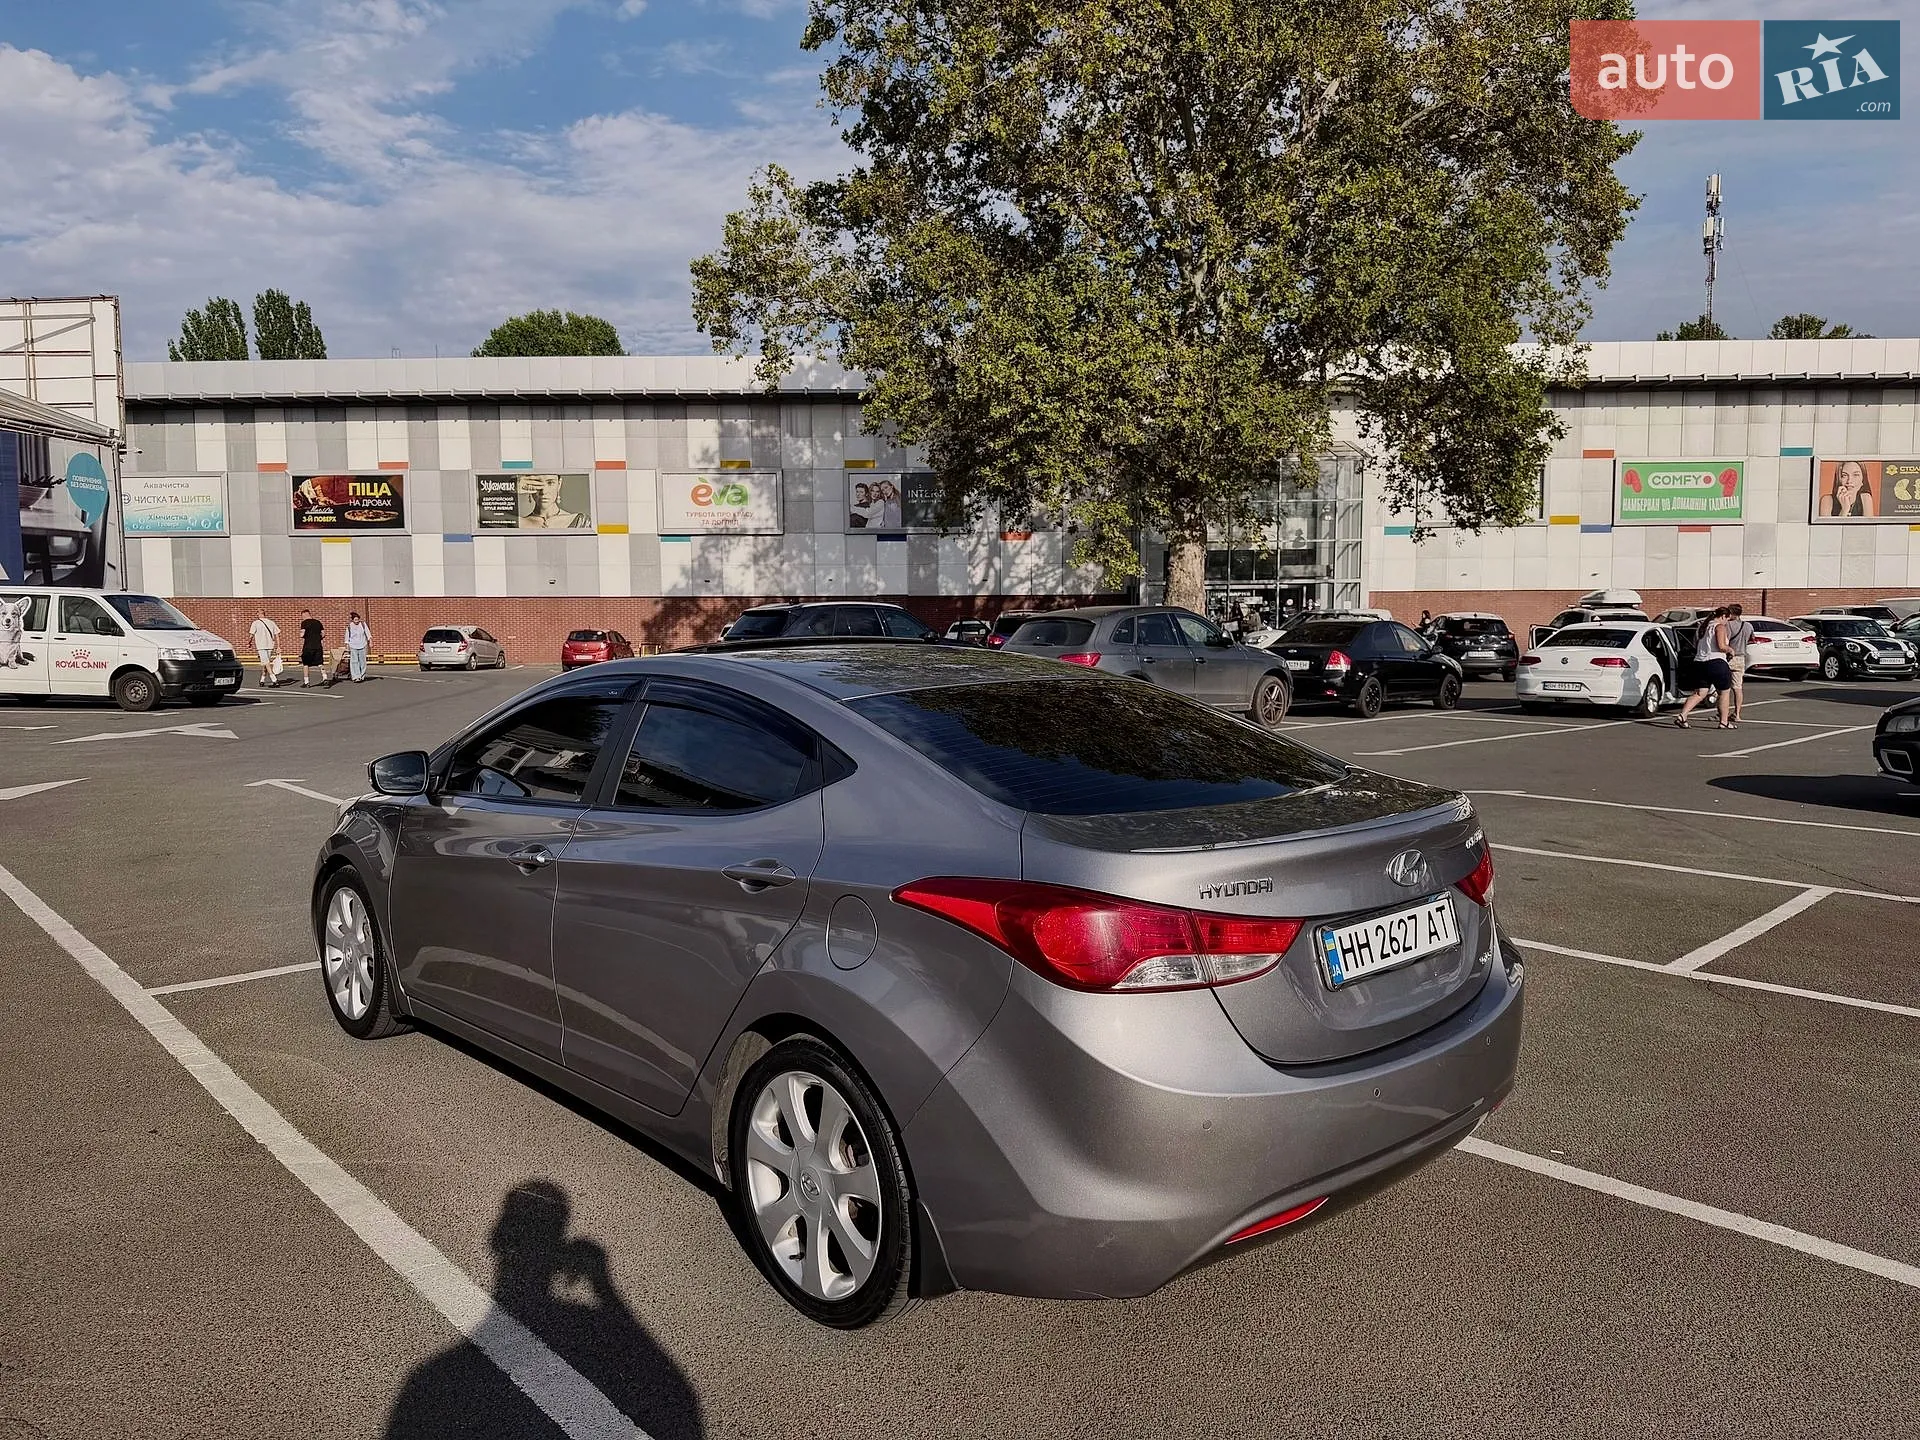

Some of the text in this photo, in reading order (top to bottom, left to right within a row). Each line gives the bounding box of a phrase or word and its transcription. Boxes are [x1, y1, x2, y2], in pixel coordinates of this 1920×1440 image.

[1652, 475, 1702, 486] COMFY
[348, 482, 392, 498] ПІЦА
[691, 482, 749, 507] eva
[133, 495, 211, 504] ЧИСТКА ТА ШИТТЯ
[349, 499, 392, 508] НА ДРОВАХ
[148, 513, 188, 521] Хімчистка
[313, 515, 337, 523] ПОВЕРХ
[55, 660, 107, 669] ROYAL CANIN
[1198, 876, 1274, 900] HYUNDAI
[1338, 905, 1449, 972] HH 2627 AT
